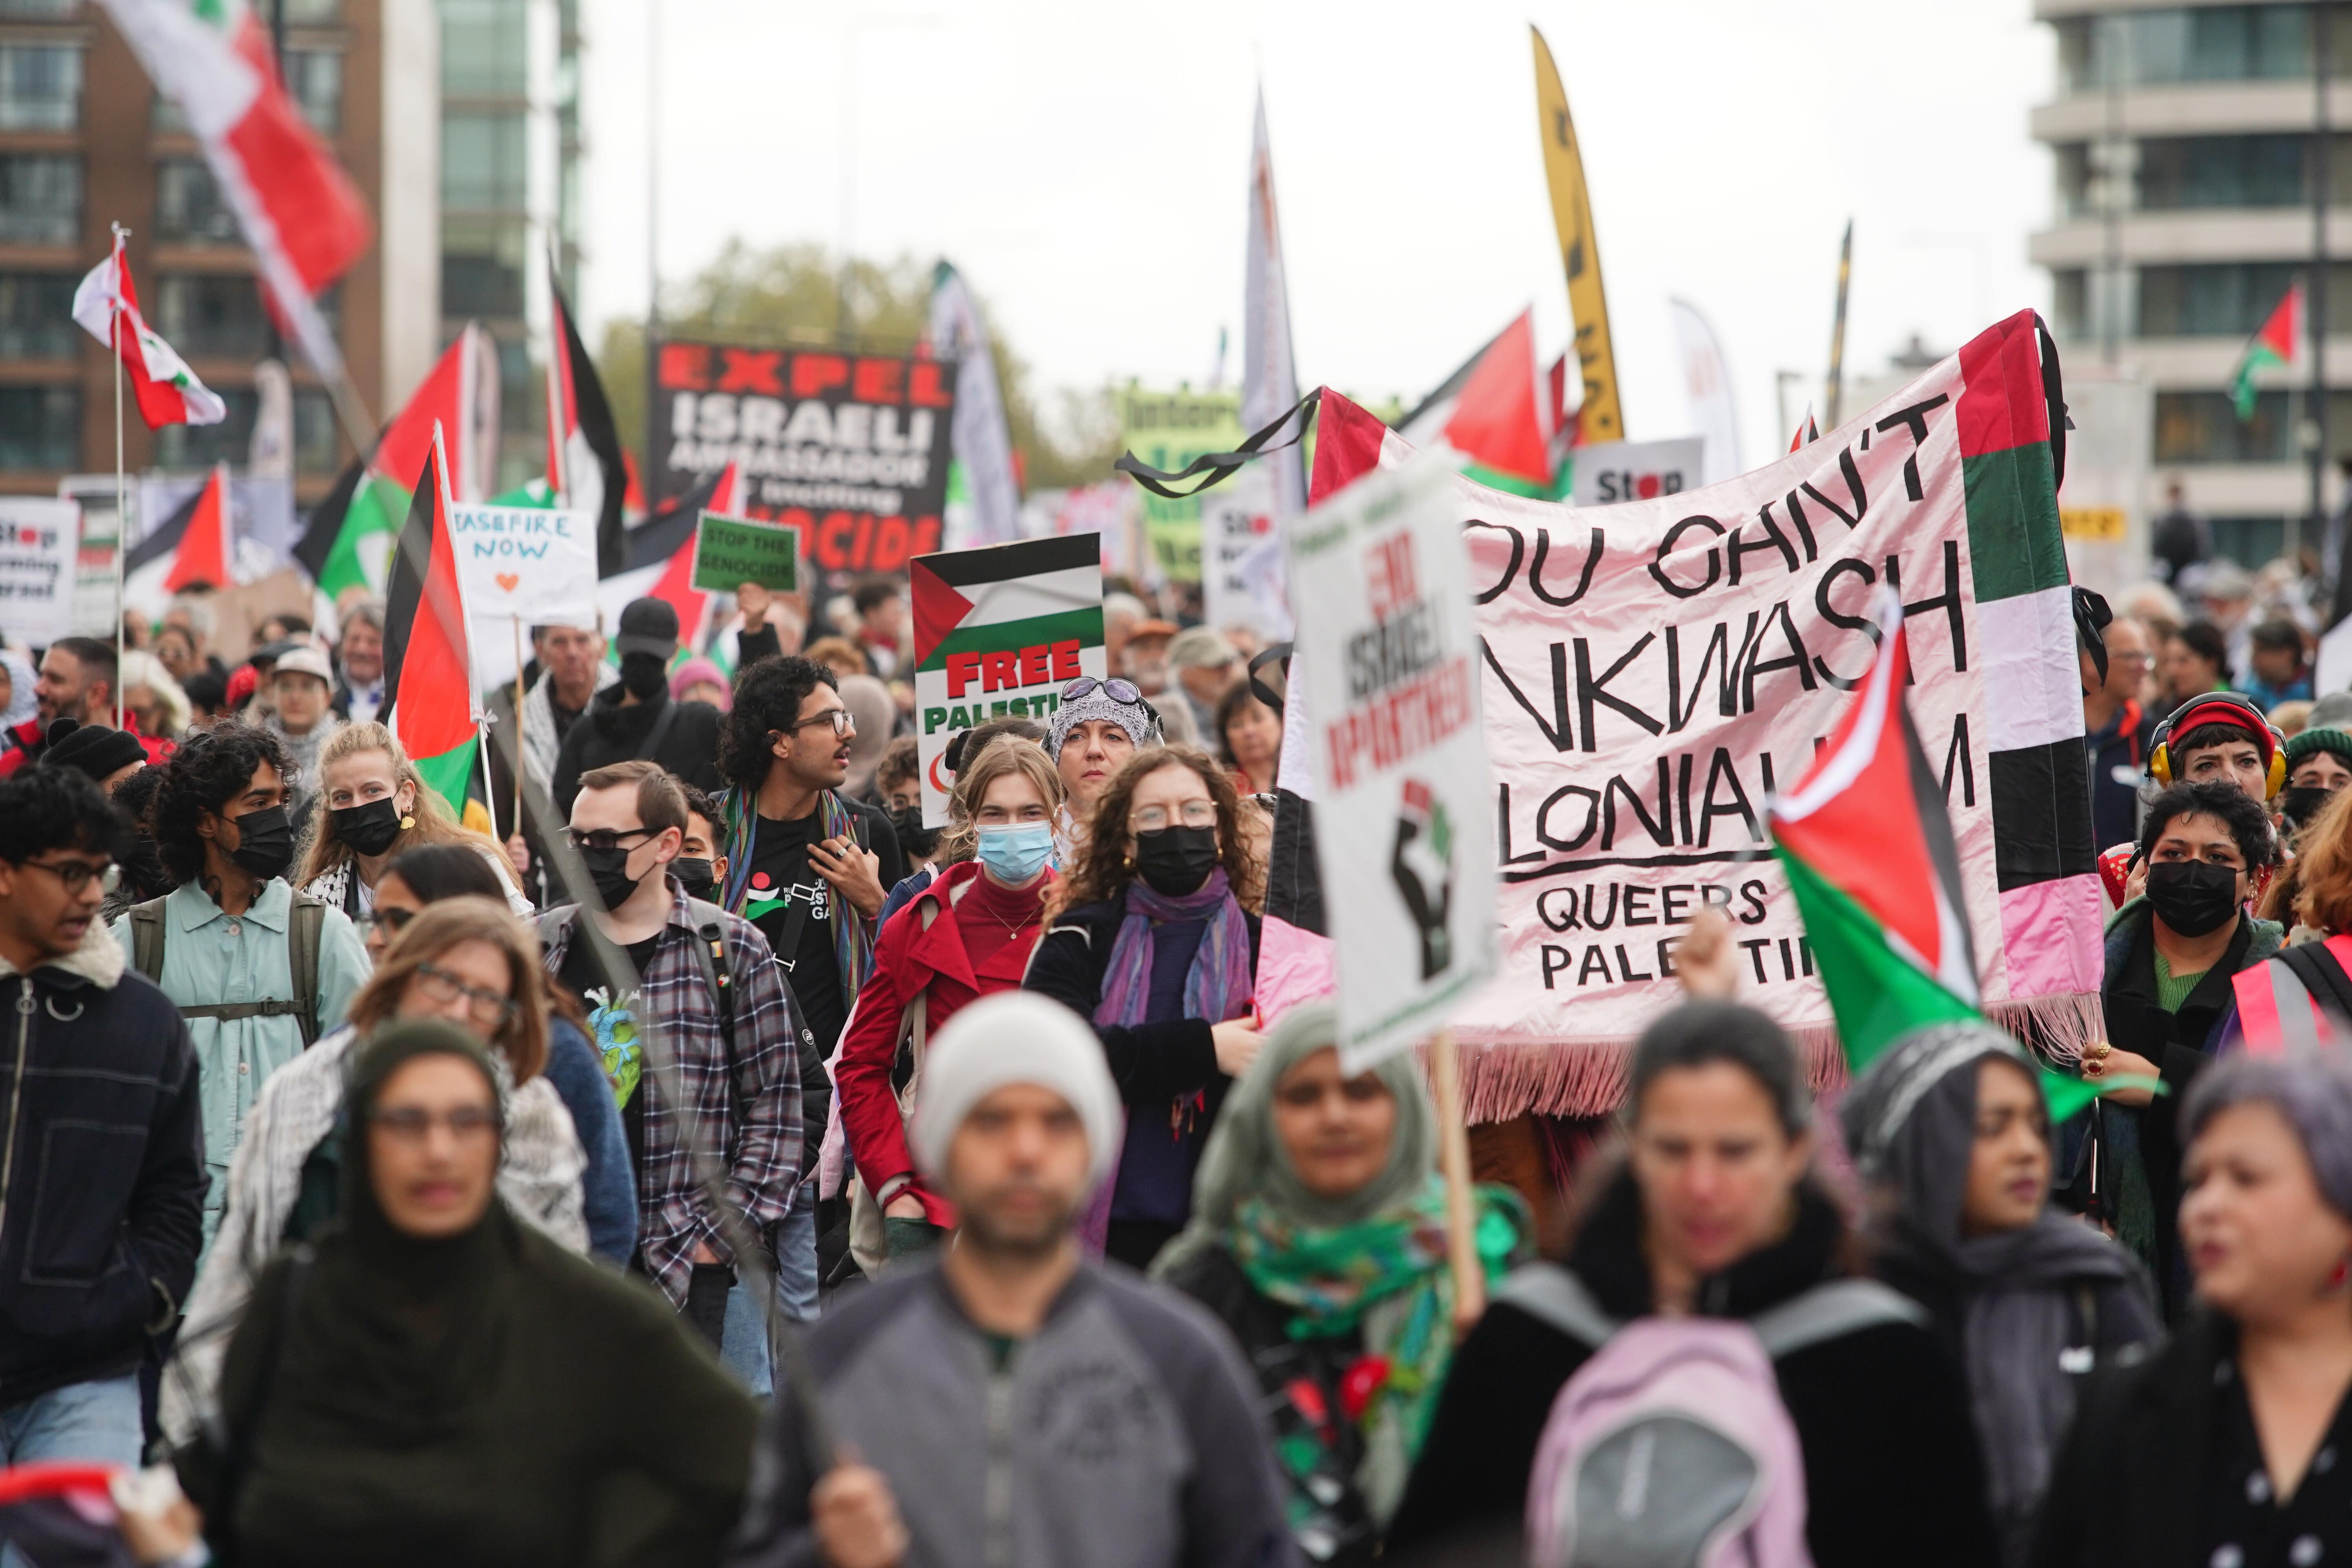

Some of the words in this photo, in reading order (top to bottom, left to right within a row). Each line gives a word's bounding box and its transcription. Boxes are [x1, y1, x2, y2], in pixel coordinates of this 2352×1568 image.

[659, 343, 952, 408] EXPEL
[671, 392, 935, 453] ISRAELI
[667, 442, 931, 488] AMBASSADOR
[1598, 469, 1683, 502] Stop
[455, 512, 571, 537] EASEFIRE
[473, 539, 548, 559] NOW
[707, 528, 748, 548] STOP
[753, 535, 788, 555] THE
[699, 552, 793, 579] GENOCIDE
[1363, 527, 1419, 620] END
[1464, 518, 1604, 607] OU
[946, 639, 1082, 699] FREE
[1480, 540, 1967, 753] NKWASH
[924, 692, 1058, 735] PALESTI
[1537, 879, 1768, 933] QUEERS
